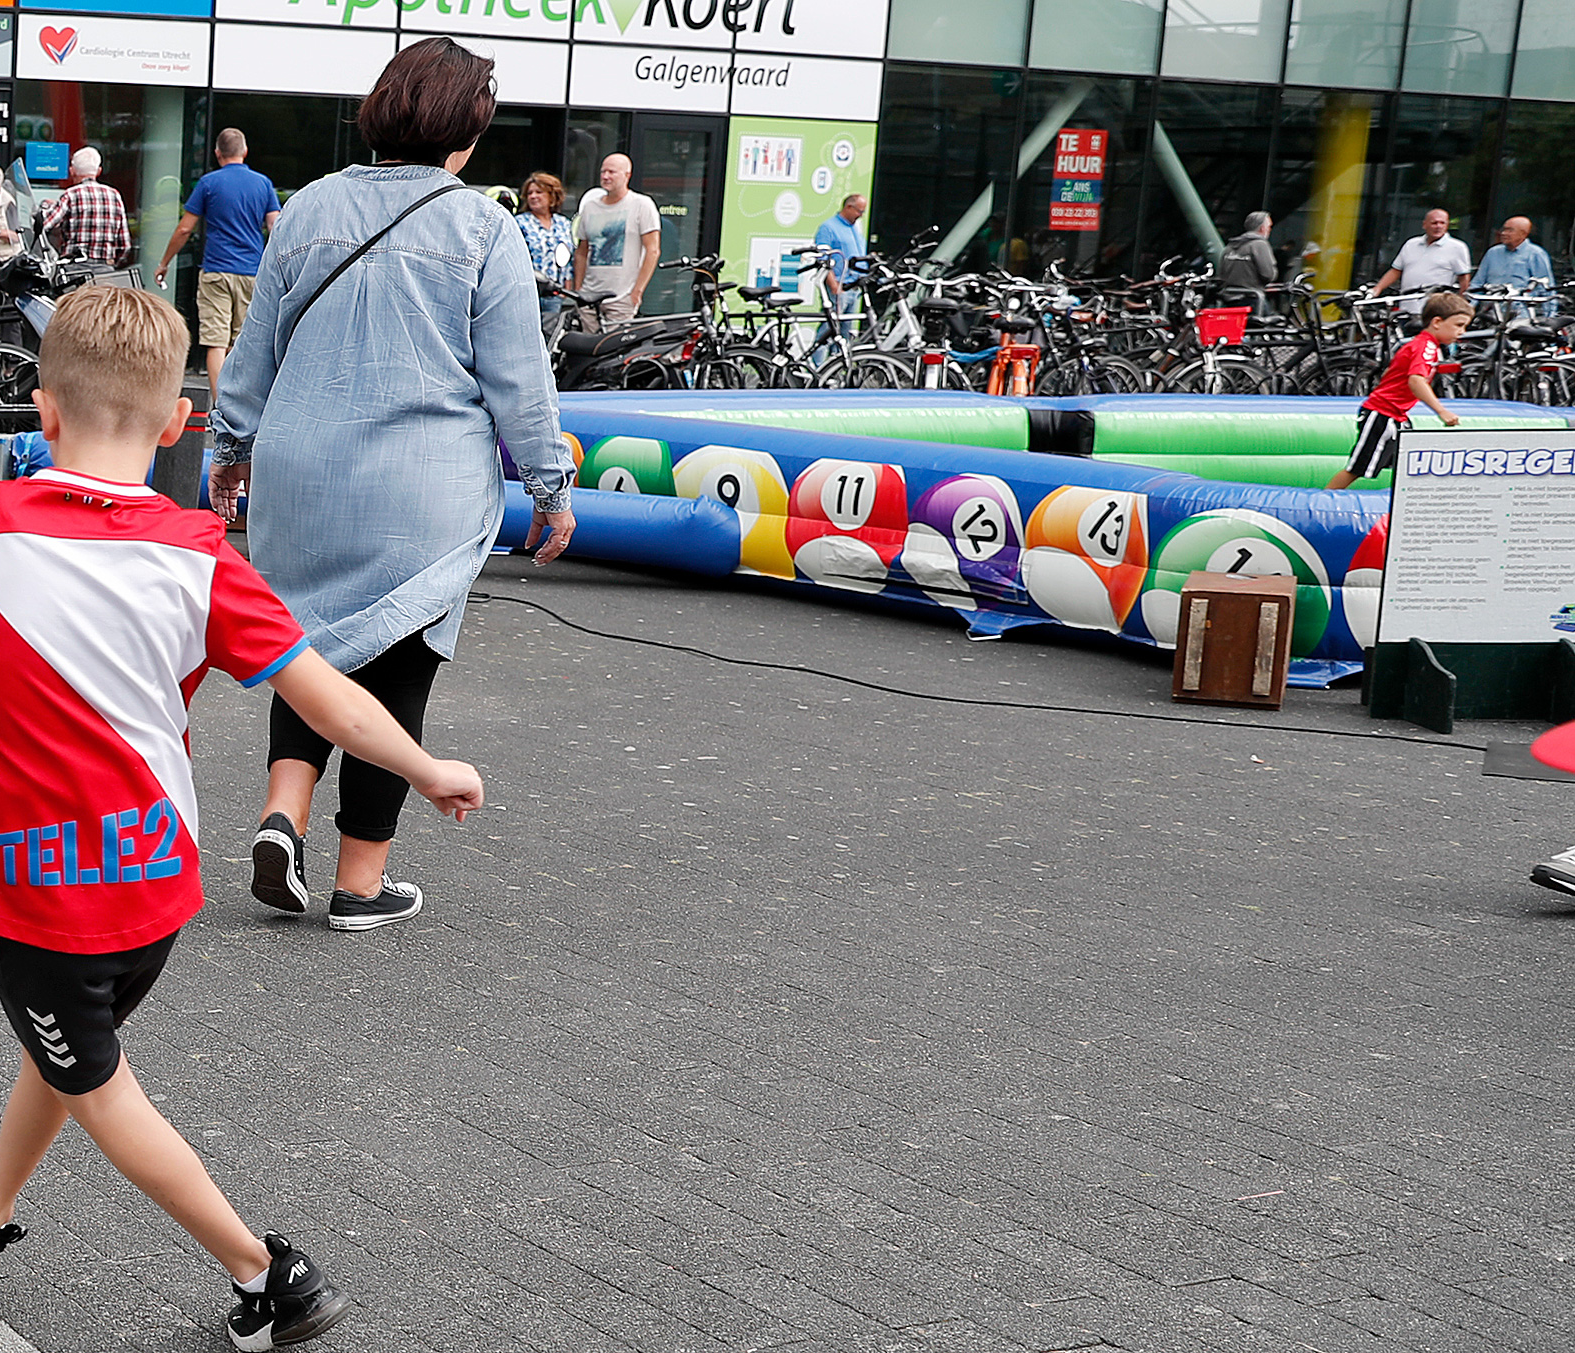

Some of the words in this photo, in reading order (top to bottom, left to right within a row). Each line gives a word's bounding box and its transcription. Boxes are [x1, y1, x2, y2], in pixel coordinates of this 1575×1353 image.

[79, 46, 125, 58] Cardiologie
[126, 49, 160, 58] Centrum
[162, 51, 191, 60] Utrecht
[634, 54, 791, 89] Galgenwaard
[1059, 134, 1079, 152] TE
[1057, 155, 1102, 174] HUUR
[659, 204, 688, 216] entree
[1407, 449, 1575, 476] HUISREGE
[717, 474, 741, 509] 9
[836, 475, 864, 516] 11
[960, 503, 998, 554] 12
[1088, 501, 1124, 556] 13
